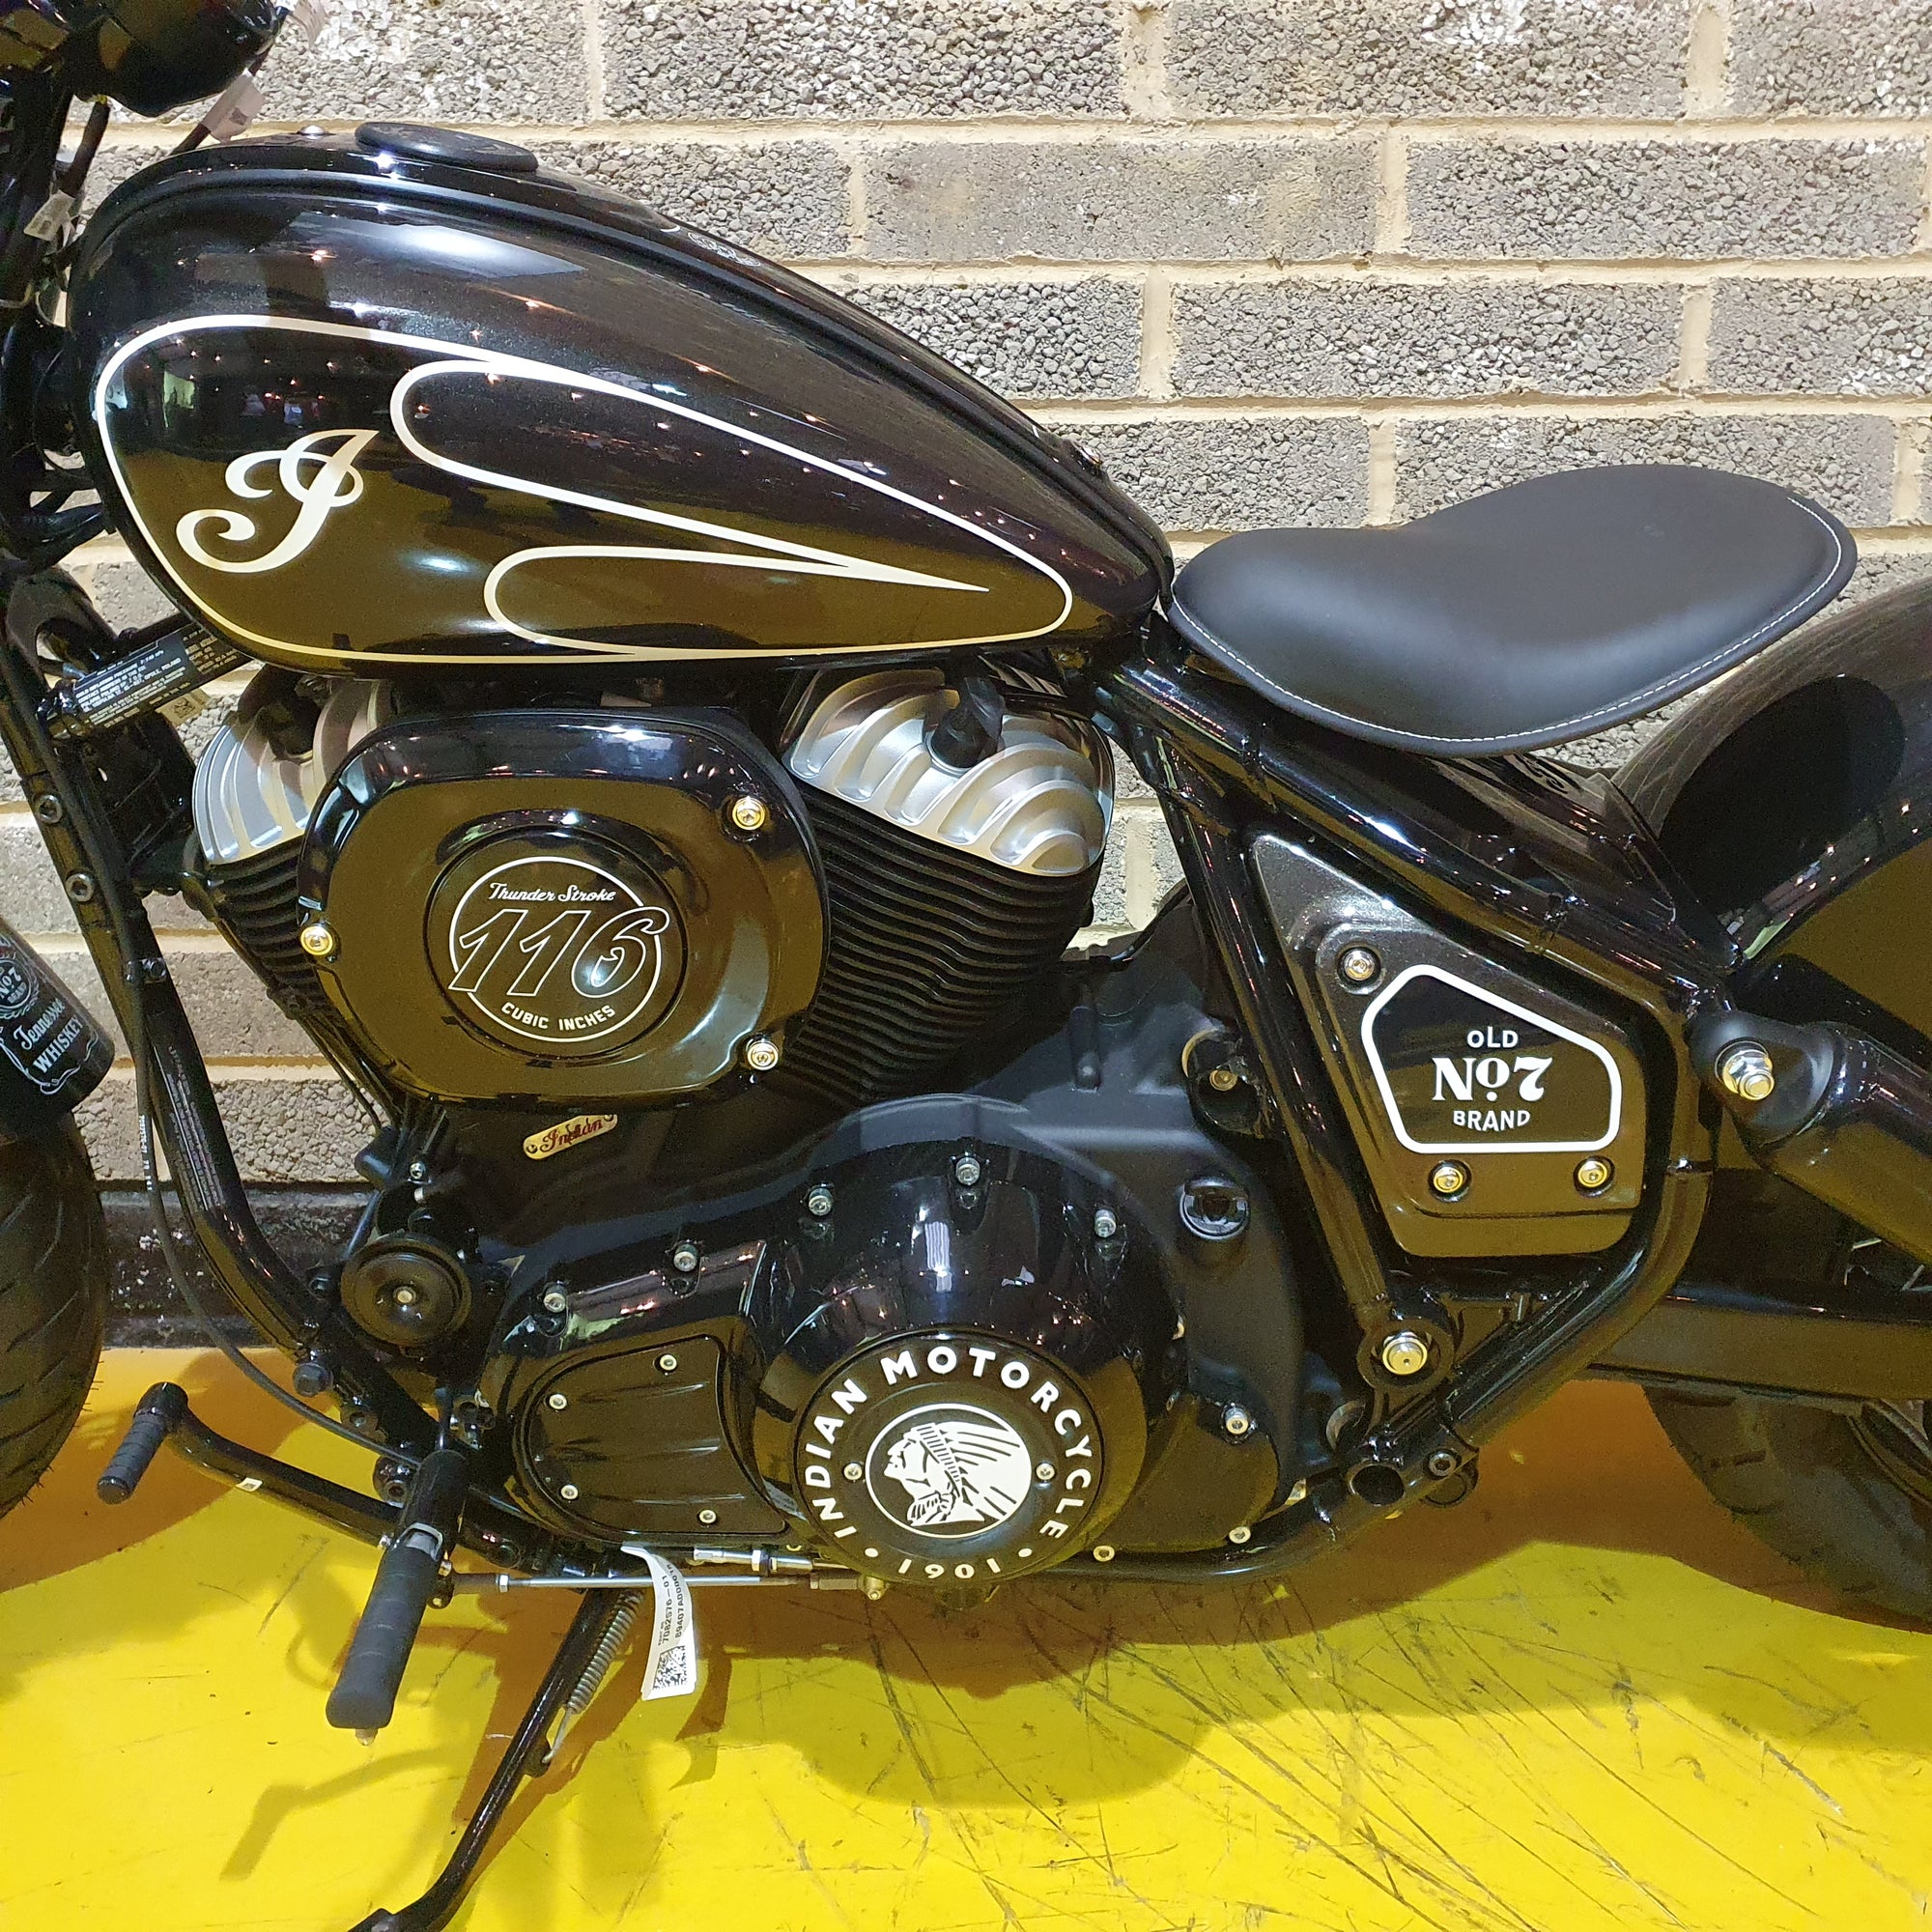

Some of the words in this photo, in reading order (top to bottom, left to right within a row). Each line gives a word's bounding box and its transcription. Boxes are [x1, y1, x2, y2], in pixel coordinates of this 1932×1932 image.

[488, 882, 556, 901] Thunder
[557, 884, 617, 902] Stroke
[447, 906, 670, 999] 116
[13, 997, 67, 1051] Tennessee
[500, 1002, 550, 1030] CUBIC
[558, 1005, 616, 1031] INCHES
[33, 1014, 83, 1074] WHISKEY
[1466, 1026, 1519, 1048] OLD
[539, 1118, 604, 1153] Indian
[1453, 1110, 1531, 1131] BRAND
[805, 1378, 868, 1539] INDIAN
[880, 1346, 1093, 1540] MOTORCYCLE
[898, 1557, 1002, 1579] 1901
